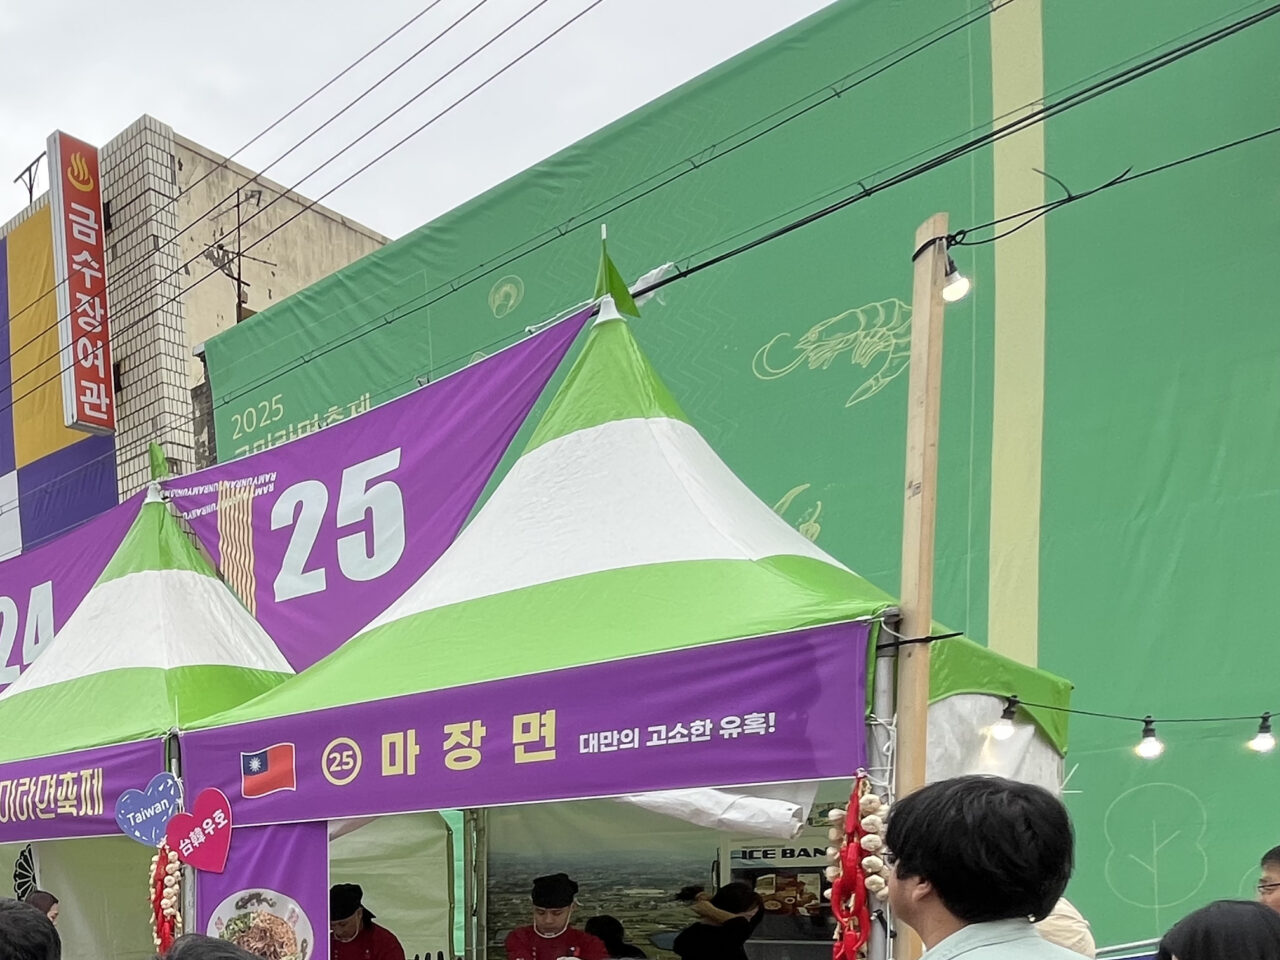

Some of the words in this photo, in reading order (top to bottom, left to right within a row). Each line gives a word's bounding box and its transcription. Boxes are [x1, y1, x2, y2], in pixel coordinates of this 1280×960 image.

[69, 201, 110, 420] 금수장여관
[231, 393, 285, 440] 2025
[271, 447, 407, 603] 25
[579, 727, 640, 754] 대만의
[645, 718, 714, 747] 고소한
[718, 711, 776, 739] 유혹!
[126, 798, 170, 827] Taiwan
[741, 849, 776, 860] ICE
